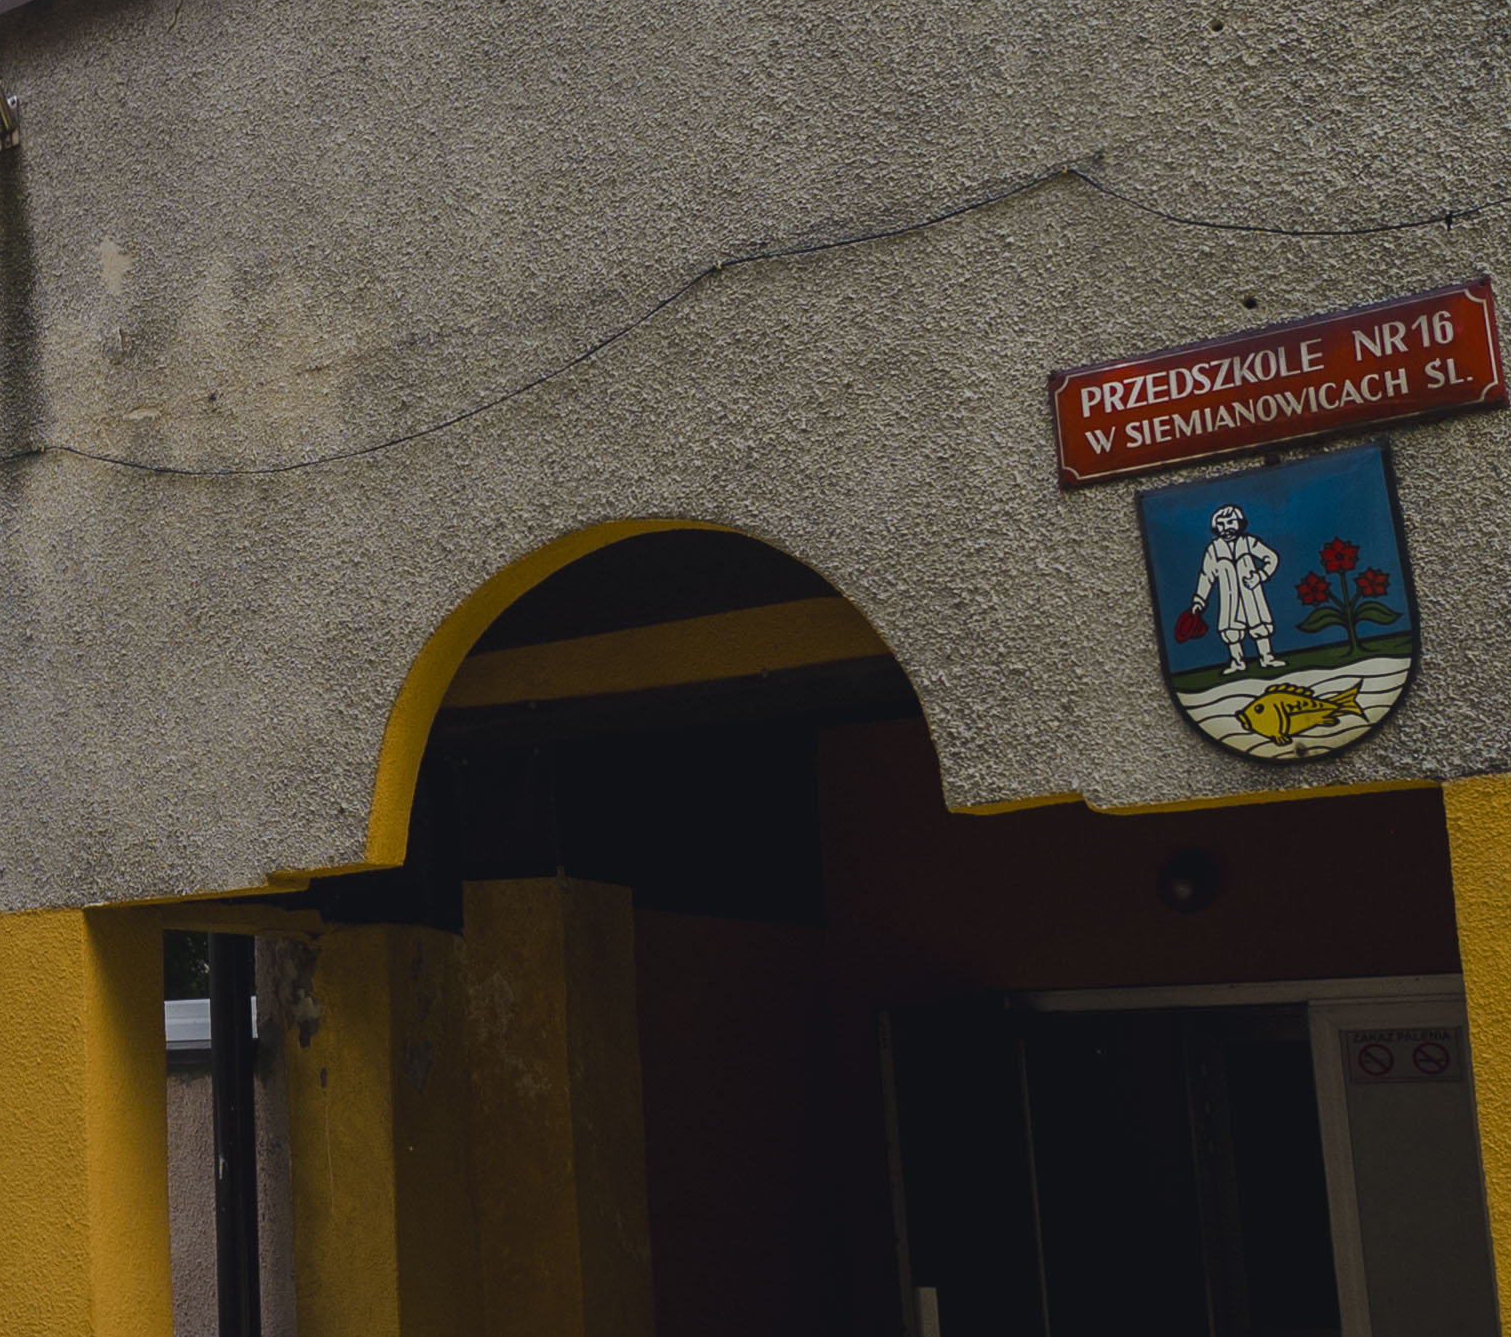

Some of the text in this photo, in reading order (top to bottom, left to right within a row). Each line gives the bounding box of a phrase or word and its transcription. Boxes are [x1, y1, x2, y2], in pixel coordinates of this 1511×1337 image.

[1080, 310, 1454, 418] PRZEDSZKOLE NR 16
[1084, 426, 1116, 455] W
[1125, 367, 1409, 448] SIEMIANOWICACH
[1353, 1031, 1394, 1043] ZAKAZ
